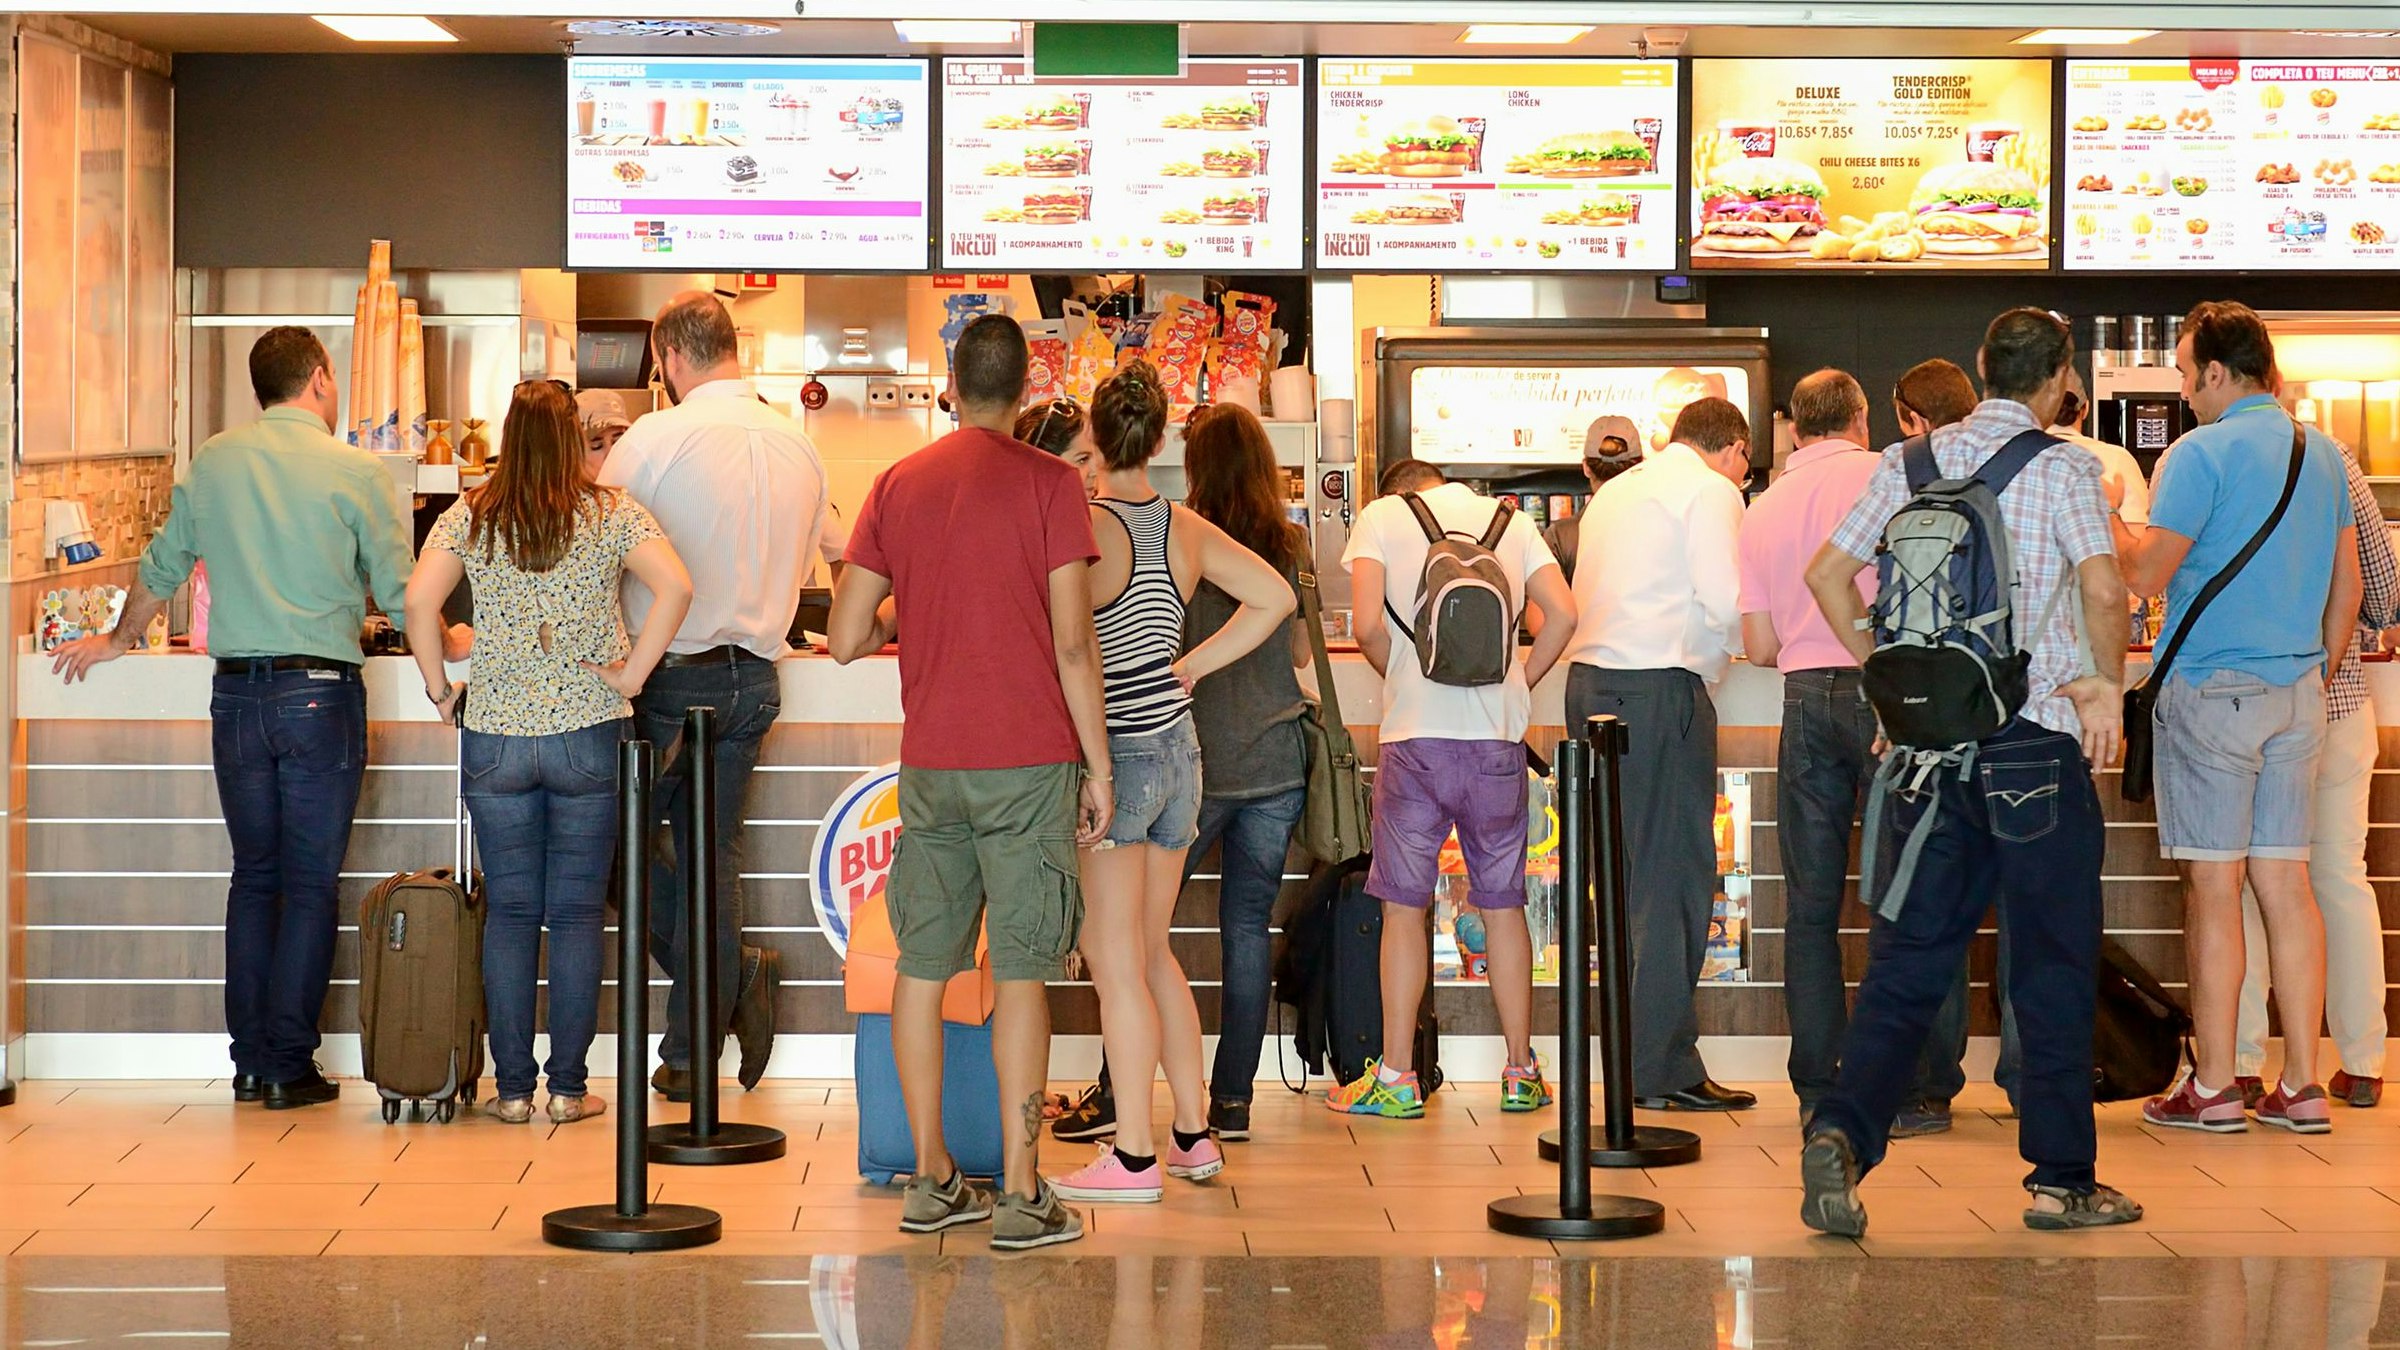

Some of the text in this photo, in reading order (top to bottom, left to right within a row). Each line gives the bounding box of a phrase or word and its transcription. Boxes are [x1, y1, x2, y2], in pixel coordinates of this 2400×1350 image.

[2252, 67, 2303, 80] COMPLETA
[2305, 67, 2313, 80] O
[2316, 67, 2335, 80] TEU
[2337, 67, 2367, 80] MENU
[753, 83, 784, 91] GELADOS
[1330, 91, 1363, 99] CHICKEN
[1508, 90, 1530, 99] LONG
[1796, 87, 1841, 99] DELUXE
[1894, 88, 1971, 100] GOLD EDITION
[1330, 99, 1384, 108] TENDERCRISP
[1508, 99, 1541, 107] CHICKEN
[604, 149, 650, 157] SOBREMESAS
[1819, 157, 1920, 167] CHILI CHEESE BITES X6
[574, 200, 622, 214] BEBIDAS
[574, 232, 630, 241] REFRIGERANTES
[754, 234, 784, 242] CERVEJA
[958, 233, 972, 241] TEU
[975, 233, 997, 241] MENU
[1206, 237, 1235, 245] BEBIDA
[1332, 233, 1347, 241] TEU
[1349, 233, 1371, 241] MENU
[951, 240, 997, 256] INCLUI
[1009, 240, 1083, 249] ACOMPANHAMENTO
[1216, 245, 1235, 253] KING
[1325, 241, 1371, 256] INCLUI
[1383, 241, 1457, 249] ACOMPANHAMENTO
[1590, 246, 1609, 254] KING
[1513, 371, 1524, 381] de
[1526, 371, 1552, 381] servir
